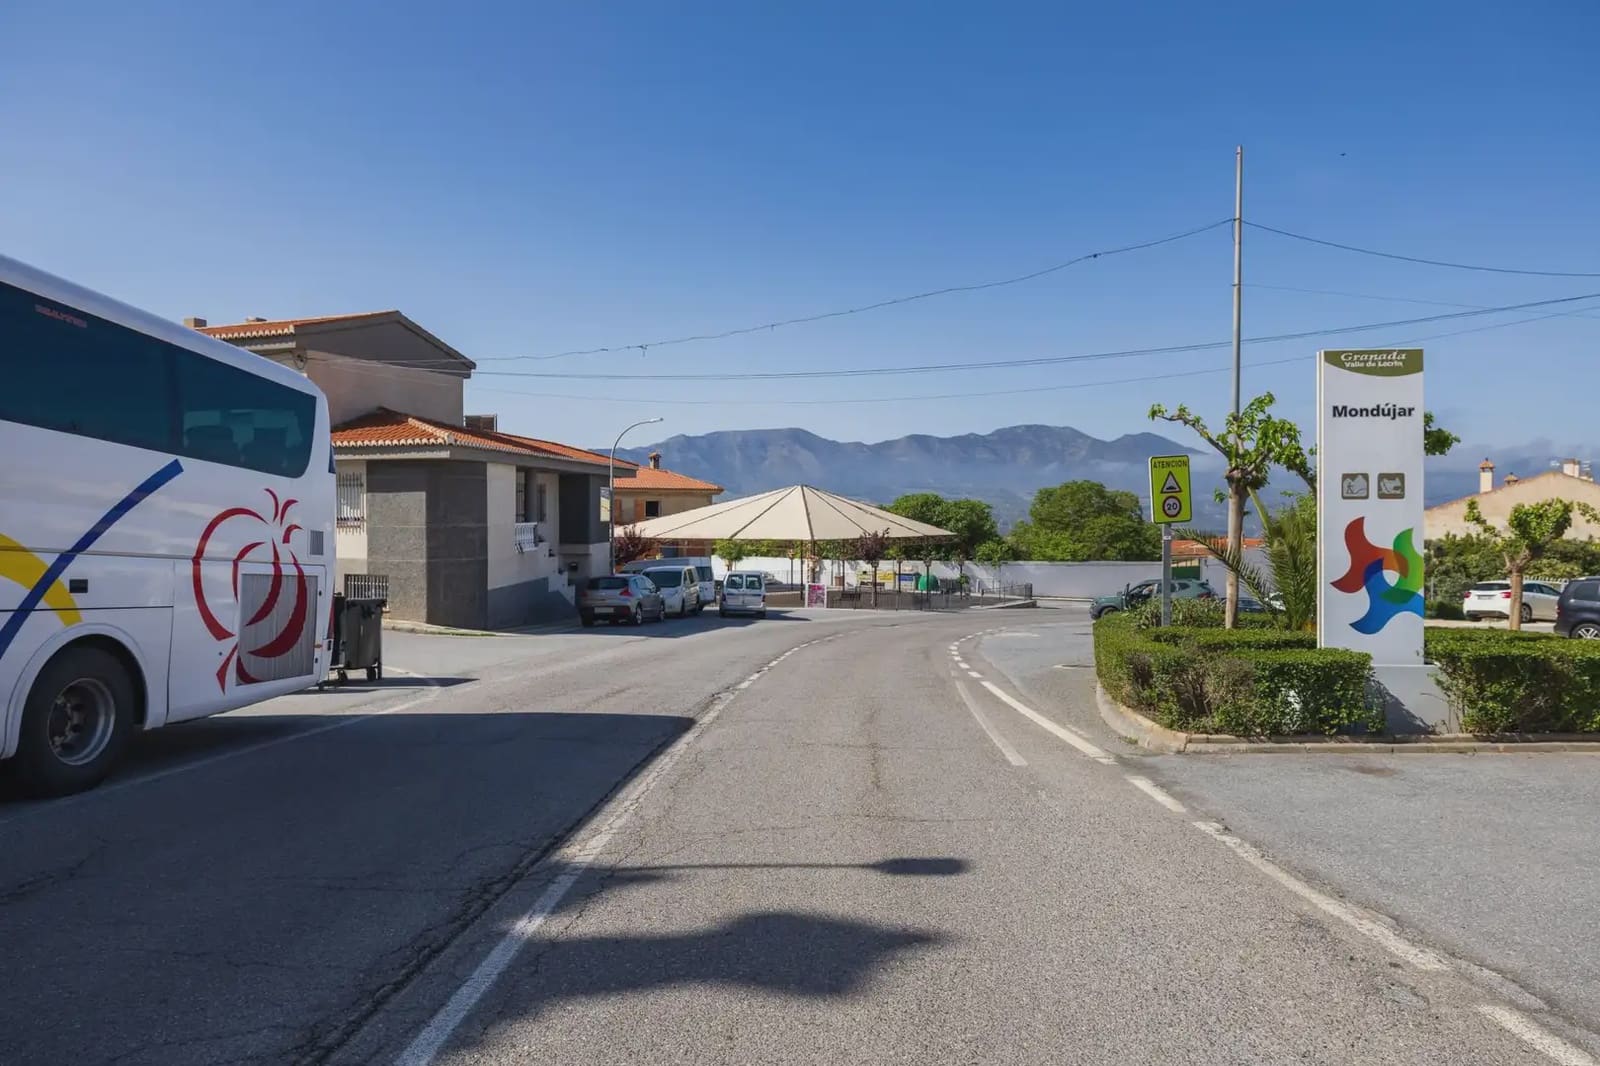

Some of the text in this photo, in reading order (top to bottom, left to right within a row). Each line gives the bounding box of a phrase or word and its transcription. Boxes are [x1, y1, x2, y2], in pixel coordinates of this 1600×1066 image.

[1340, 350, 1406, 361] Granada
[1332, 402, 1415, 420] Mondújar
[1166, 502, 1178, 510] 20
